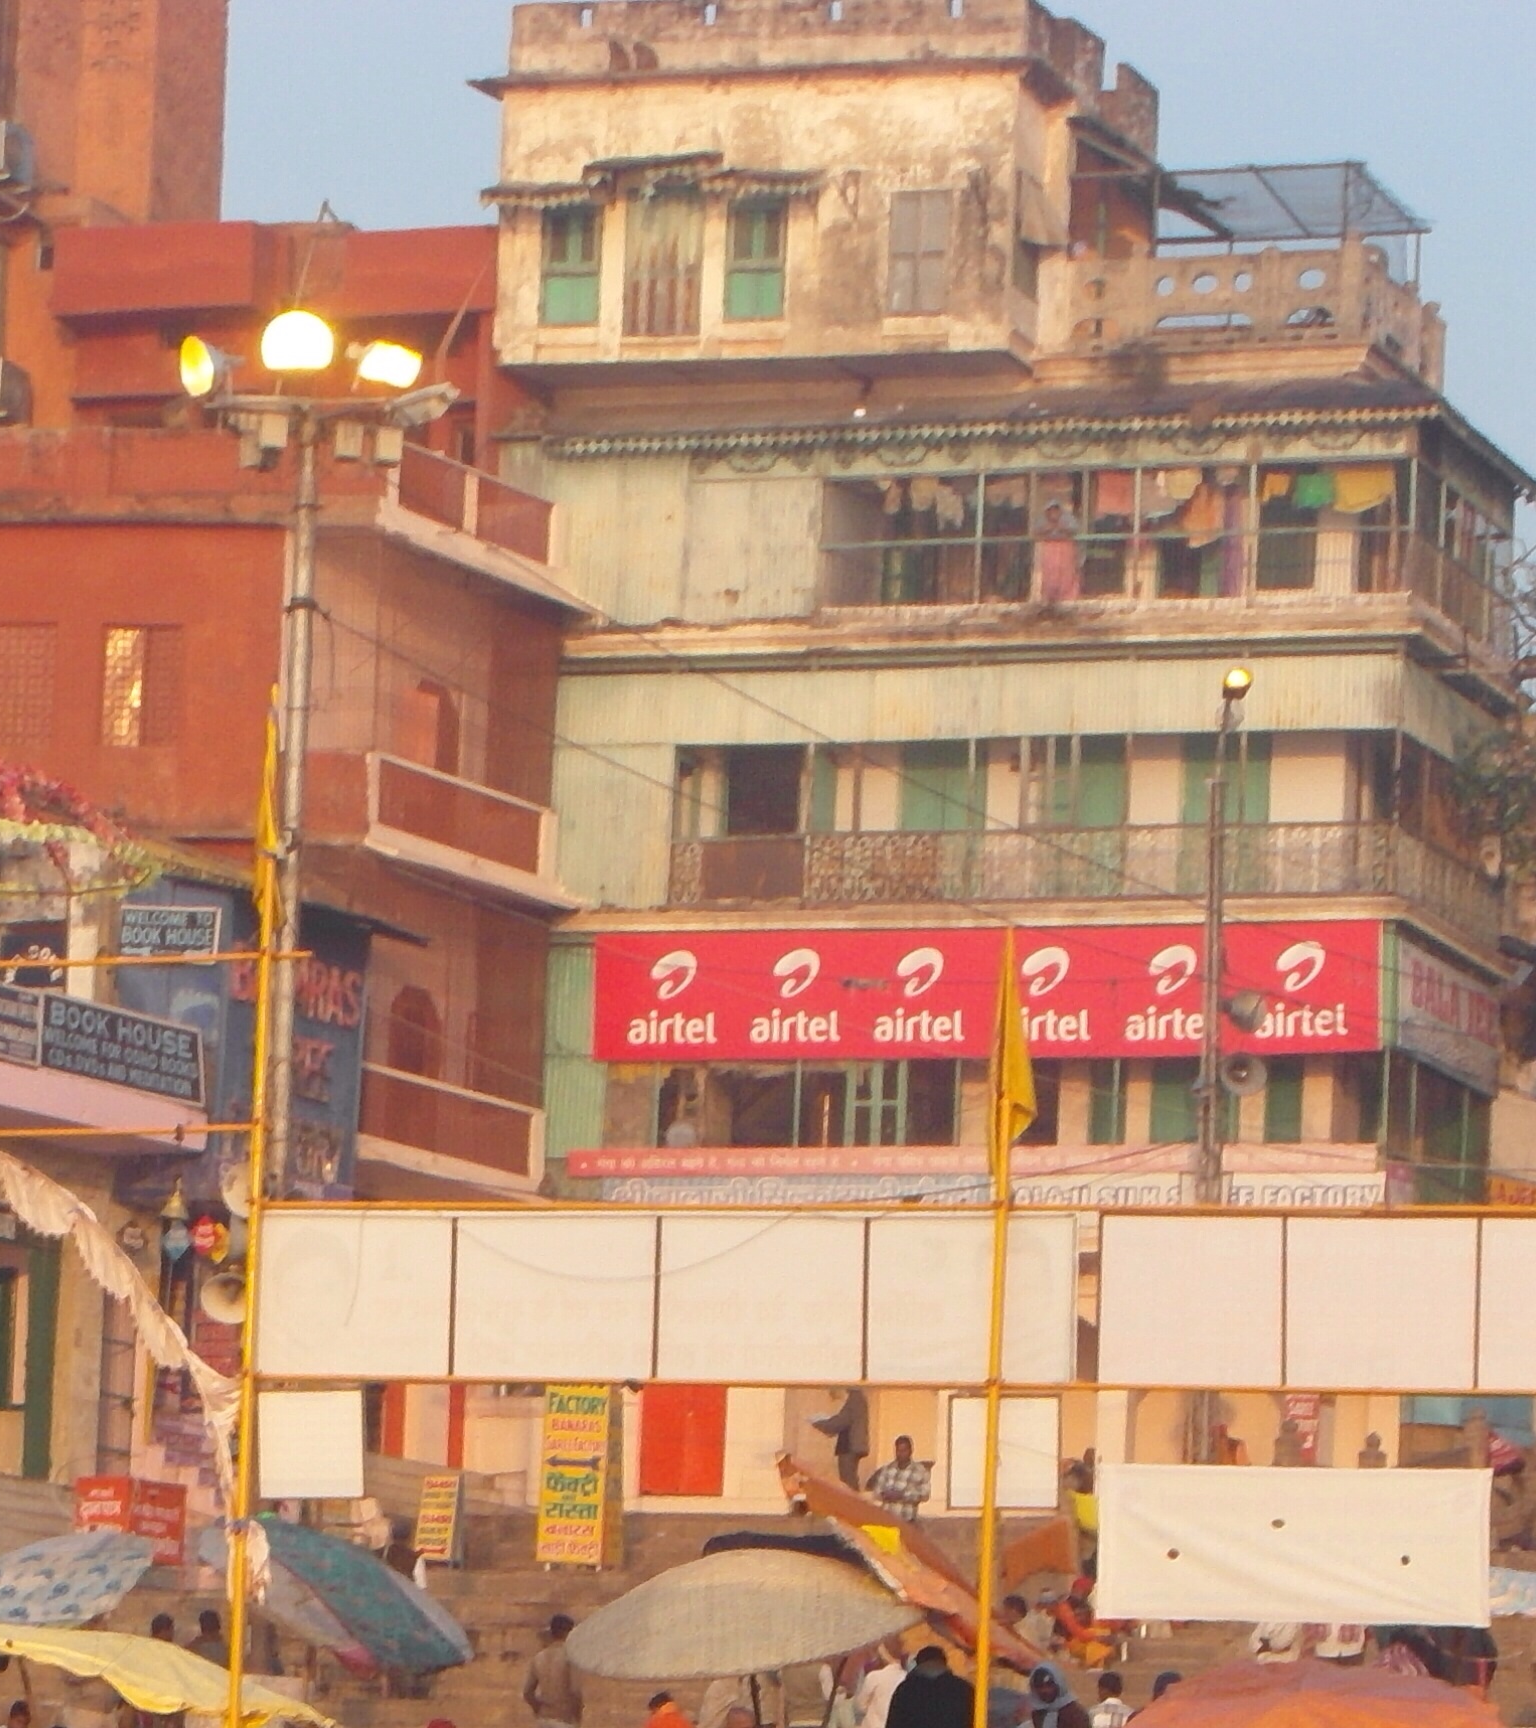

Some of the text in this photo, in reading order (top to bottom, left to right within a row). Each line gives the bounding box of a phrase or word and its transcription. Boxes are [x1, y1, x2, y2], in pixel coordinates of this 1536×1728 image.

[124, 910, 188, 926] WELCOME
[122, 926, 214, 946] BOOK HOUSE
[50, 1000, 112, 1038] BOOK
[117, 1016, 194, 1059] HOUSE
[627, 1009, 718, 1045] airtel
[750, 1007, 841, 1044] airtel
[873, 1006, 966, 1043] airtel
[1022, 1006, 1092, 1042] irtel
[1125, 1005, 1205, 1042] airte
[548, 1391, 608, 1416] FACTORY
[551, 1418, 602, 1433] BANARAS
